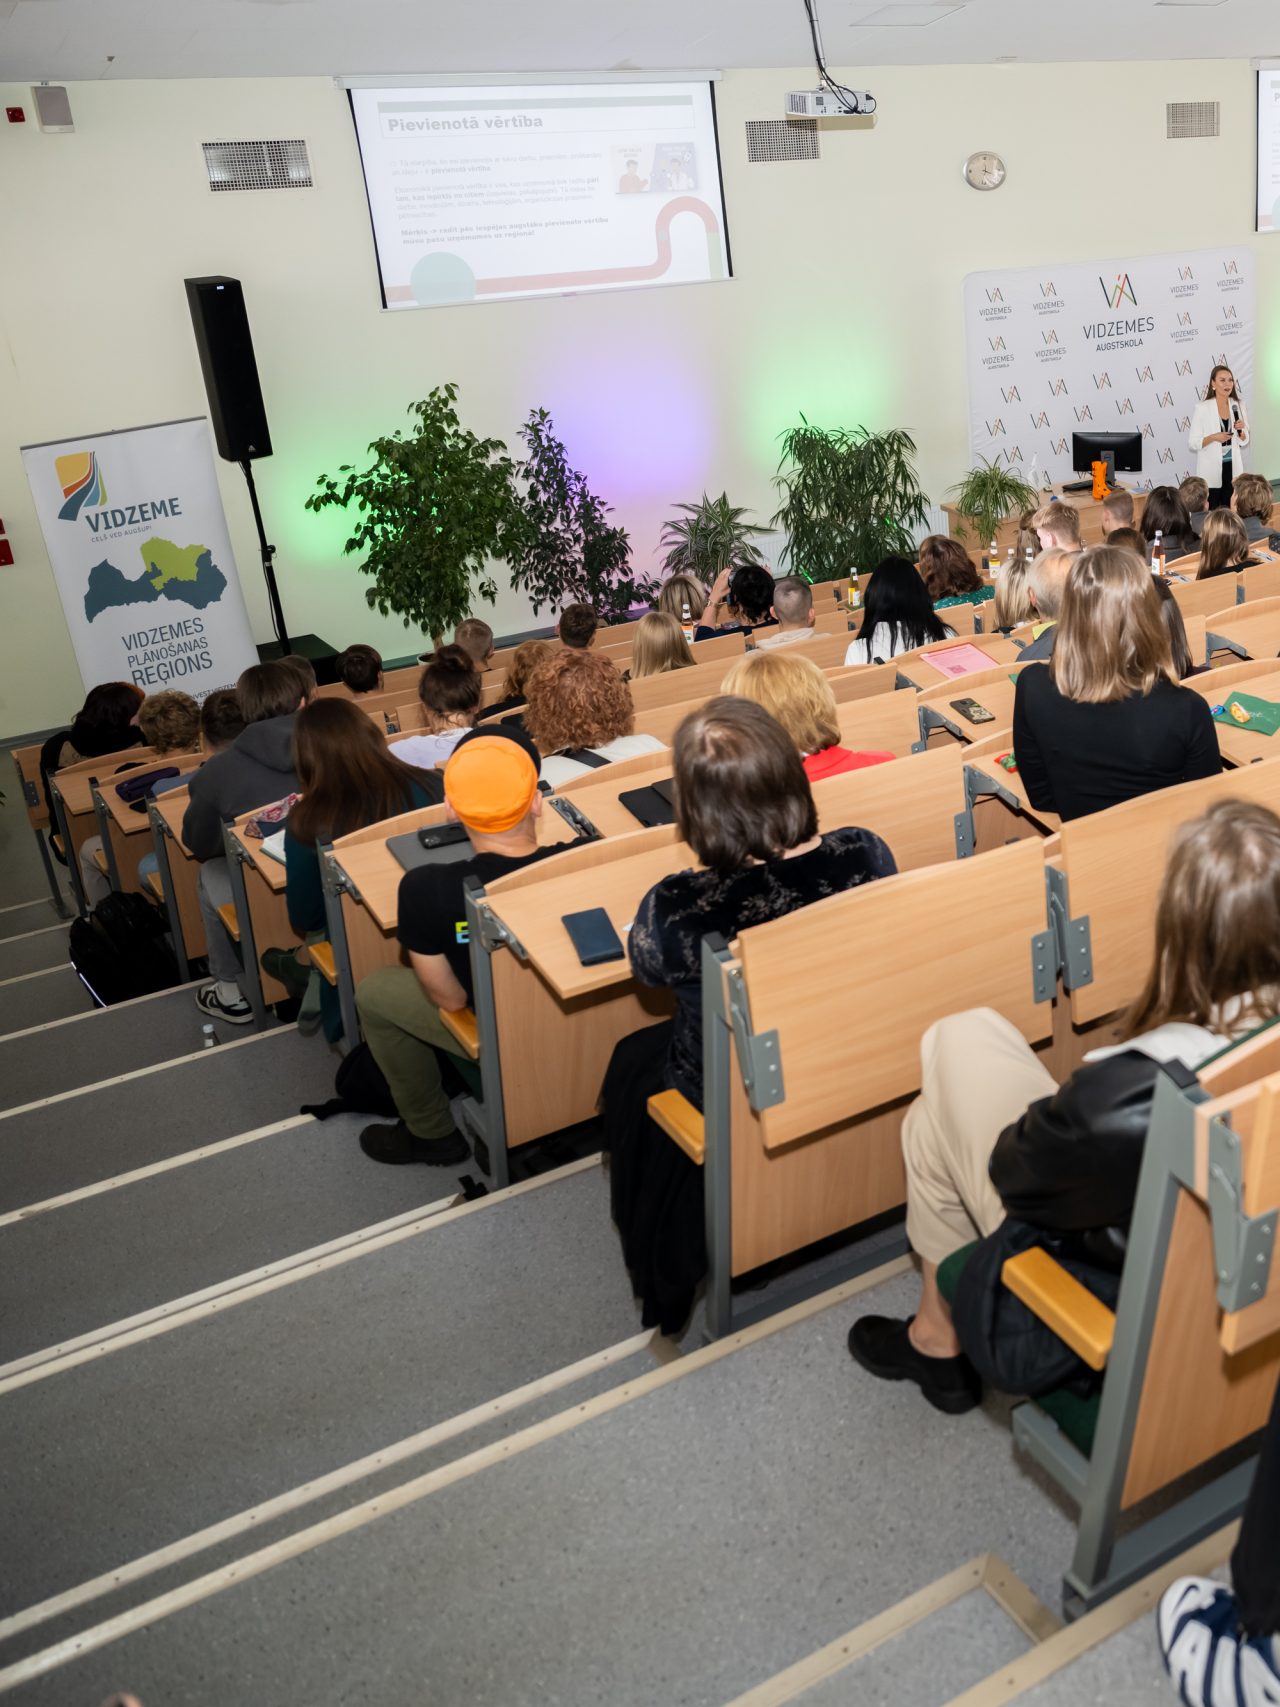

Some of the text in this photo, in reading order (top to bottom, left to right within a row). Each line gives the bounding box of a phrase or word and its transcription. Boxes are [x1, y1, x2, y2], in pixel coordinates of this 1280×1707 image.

[387, 115, 544, 132] Pievienotā vērtība
[1216, 277, 1244, 288] VIDZEMES
[1170, 284, 1199, 294] VIDZEMES
[1032, 300, 1064, 310] VIDZEMES
[979, 306, 1012, 316] VIDZEMES
[1082, 316, 1155, 340] VIDZEMES
[1216, 322, 1243, 331] VIDZEMES
[1170, 329, 1199, 338] VIDZEMES
[1096, 338, 1144, 352] AUGSTSKOLA
[1034, 347, 1067, 358] VIDZEMES
[982, 354, 1015, 365] VIDZEMES
[85, 497, 182, 533] VIDZEME
[121, 617, 204, 651] VIDZEMES
[127, 636, 208, 668] PLĀNOŠANAS
[131, 651, 213, 686] REĢIONS
